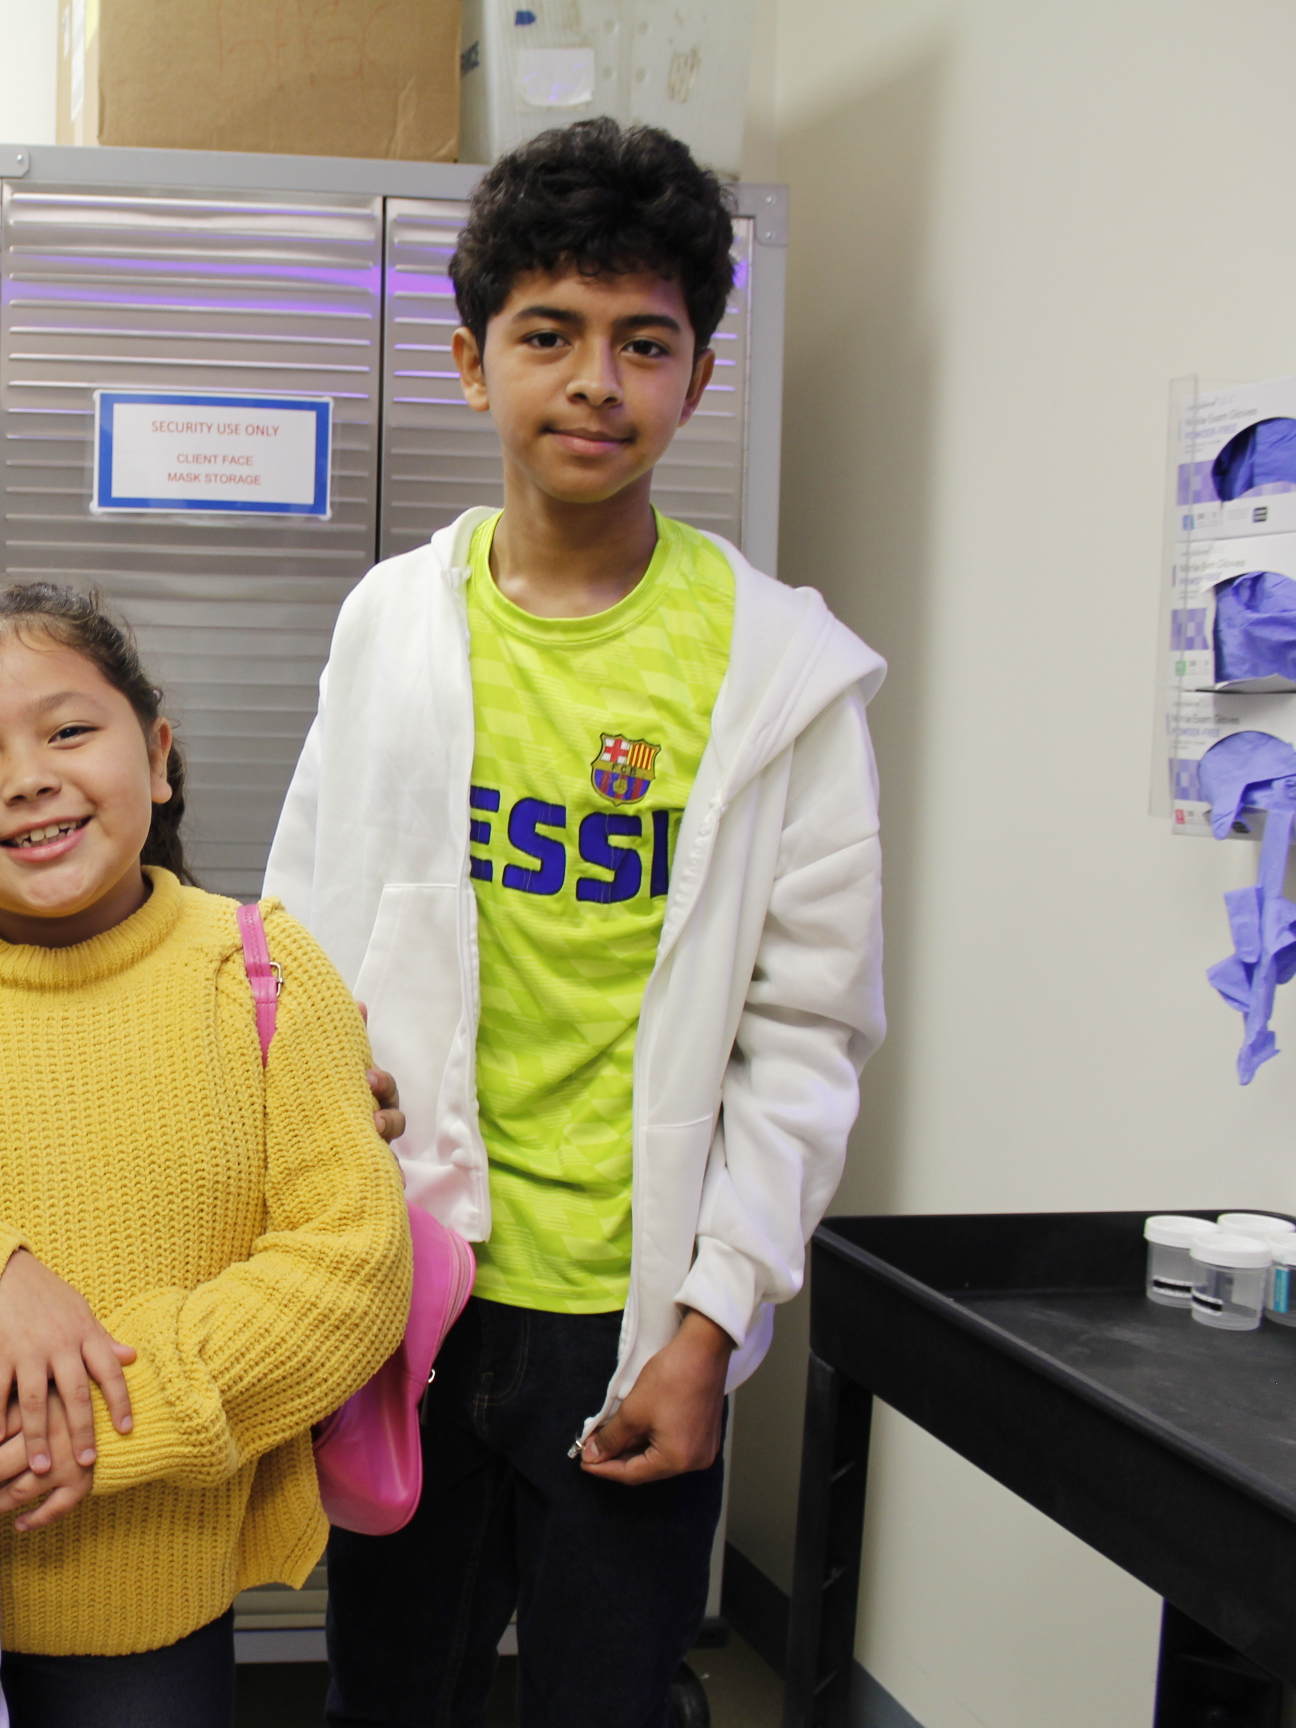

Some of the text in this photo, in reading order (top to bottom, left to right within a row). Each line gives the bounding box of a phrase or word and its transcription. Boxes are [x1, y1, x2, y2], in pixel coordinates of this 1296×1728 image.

[151, 421, 280, 437] SECURITY USE ONLY
[177, 453, 254, 466] CLIENT FACE
[167, 472, 261, 485] MASK STORAGE
[612, 763, 637, 776] FCB
